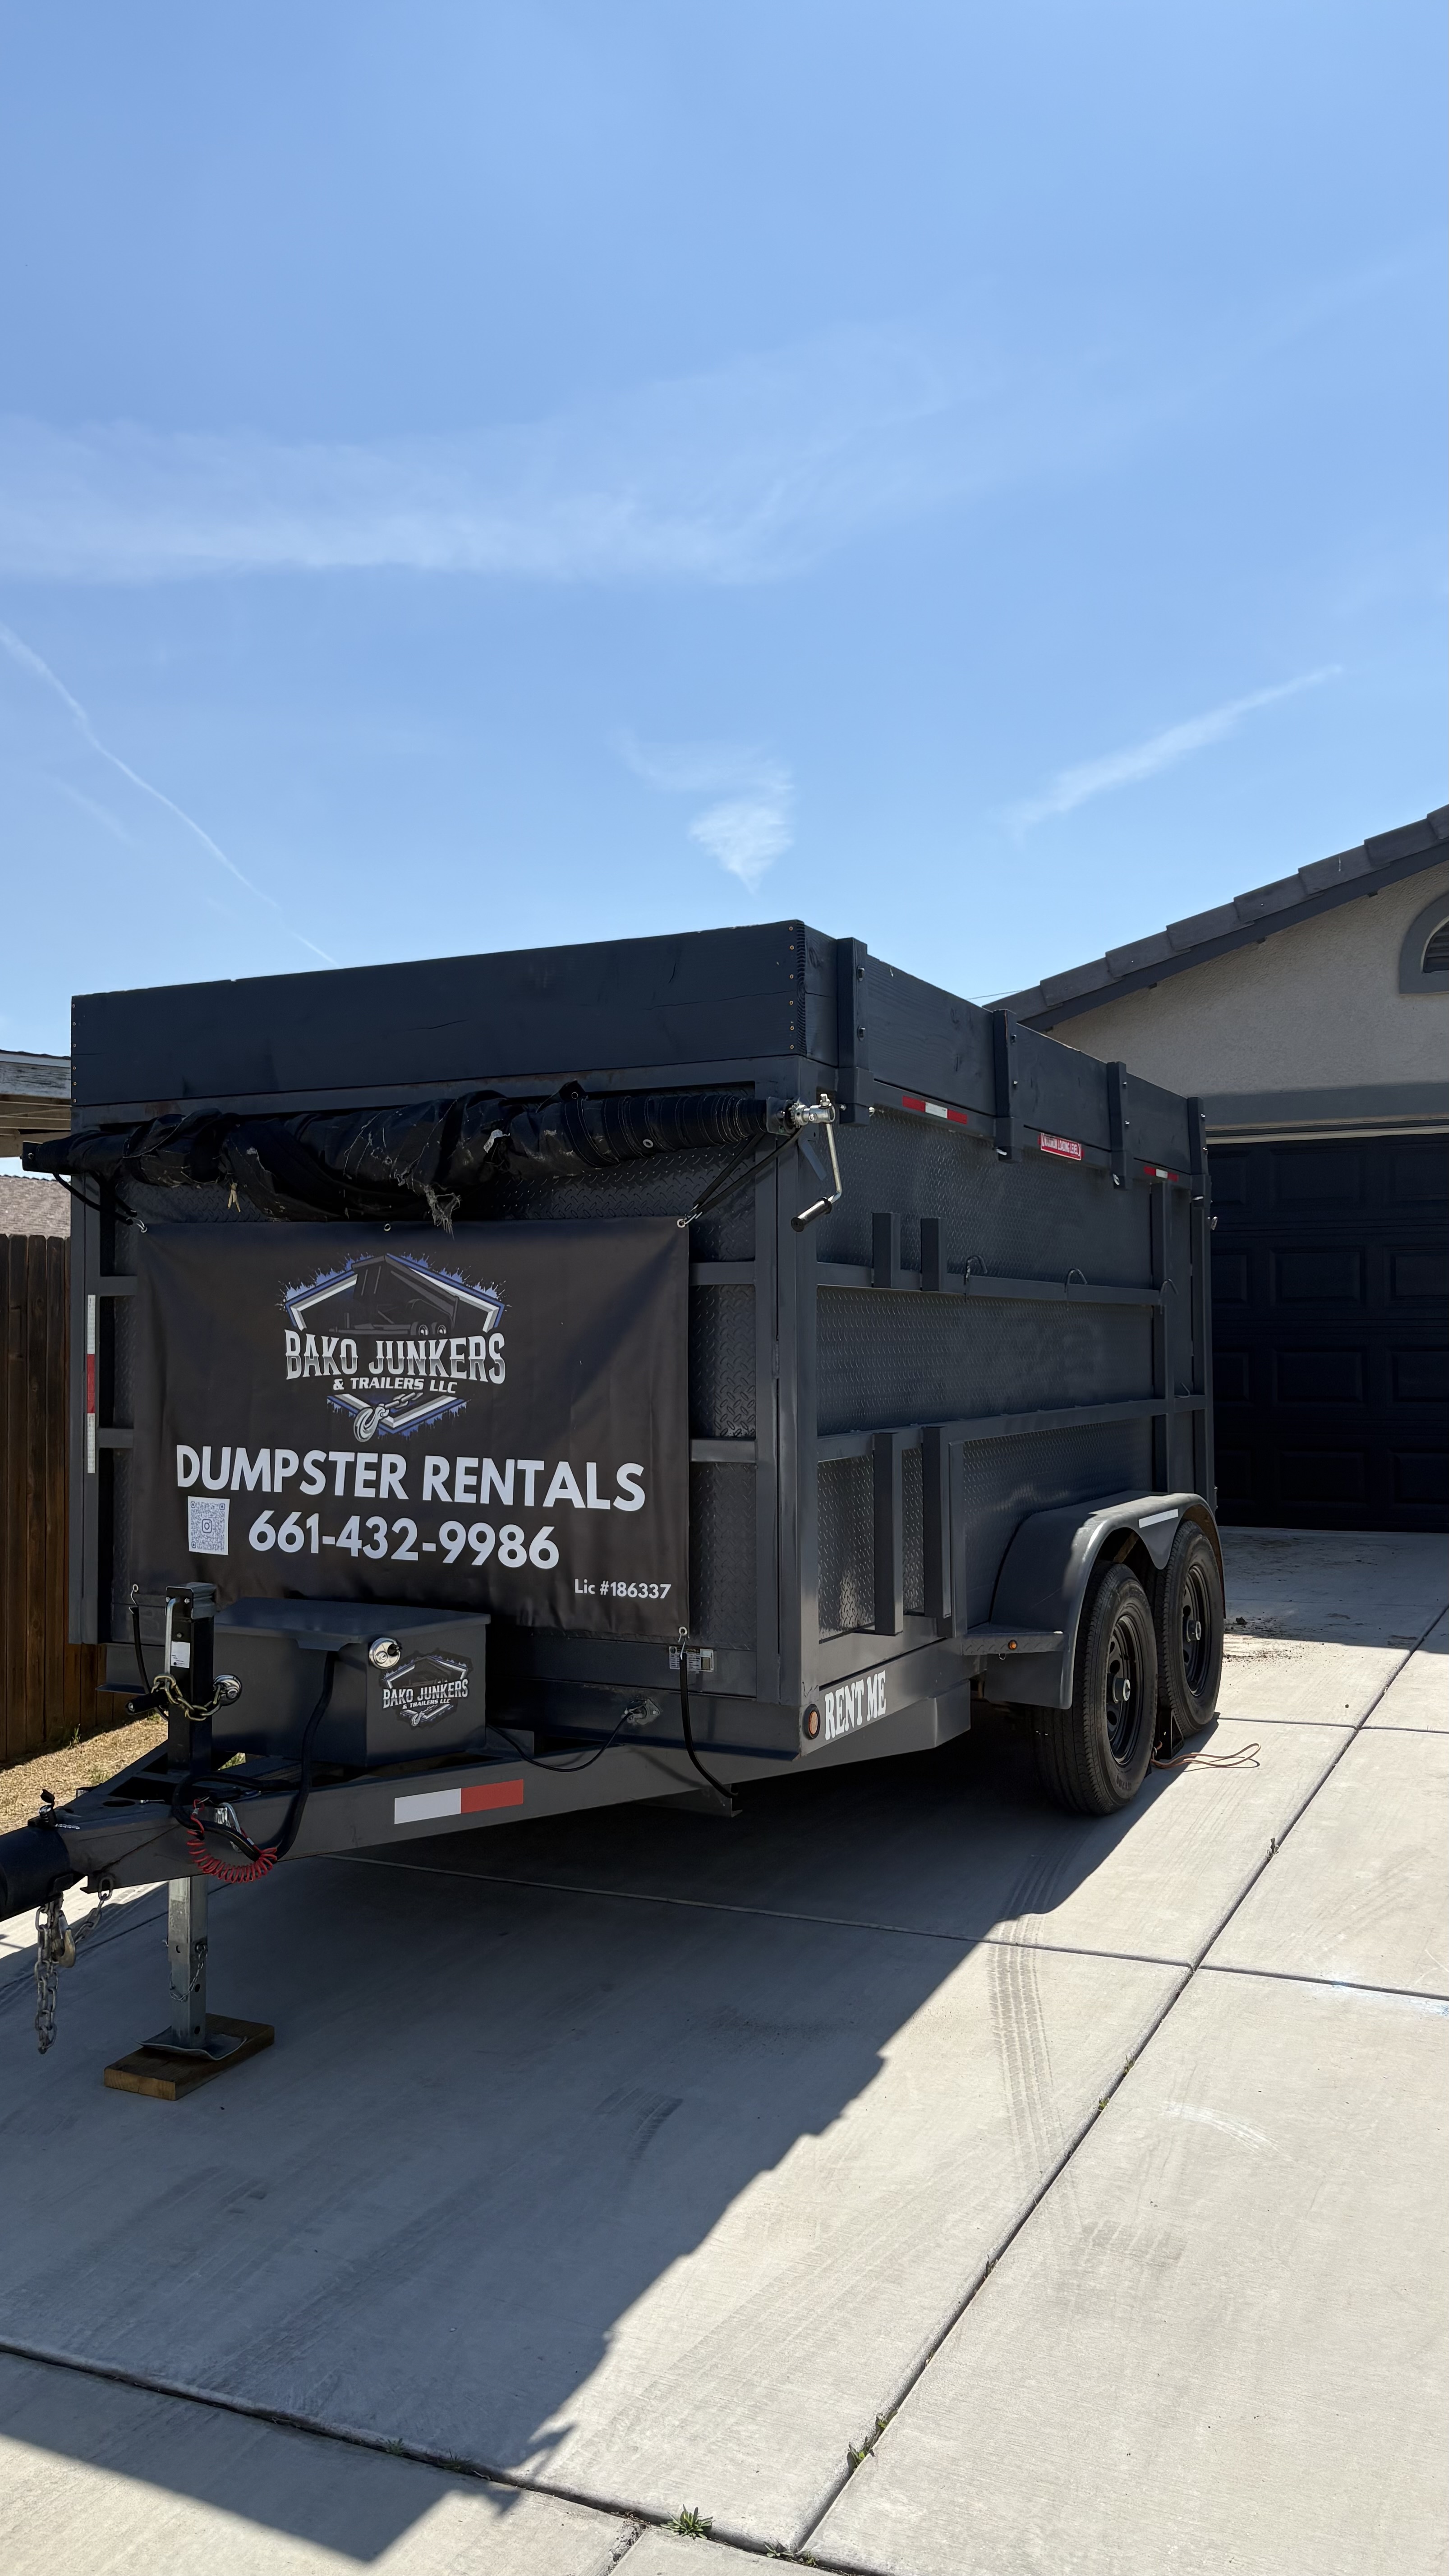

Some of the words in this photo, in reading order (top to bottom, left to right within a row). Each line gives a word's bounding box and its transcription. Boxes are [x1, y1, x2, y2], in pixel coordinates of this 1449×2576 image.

[284, 1329, 359, 1380] BAKO
[368, 1333, 506, 1384] JUNKERS
[333, 1378, 345, 1390] &
[350, 1377, 424, 1390] TRAILERS
[429, 1379, 458, 1394] LLC
[176, 1444, 409, 1500] DUMPSTER
[423, 1455, 645, 1512] RENTALS
[248, 1510, 559, 1569] 661-432-9986
[575, 1578, 595, 1594] Lic
[599, 1580, 672, 1599] #186337
[383, 1688, 414, 1709] BAKO
[417, 1679, 469, 1702] JUNKERS
[409, 1698, 438, 1708] TRAILERS
[825, 1679, 864, 1740] RENT
[867, 1670, 886, 1721] ME
